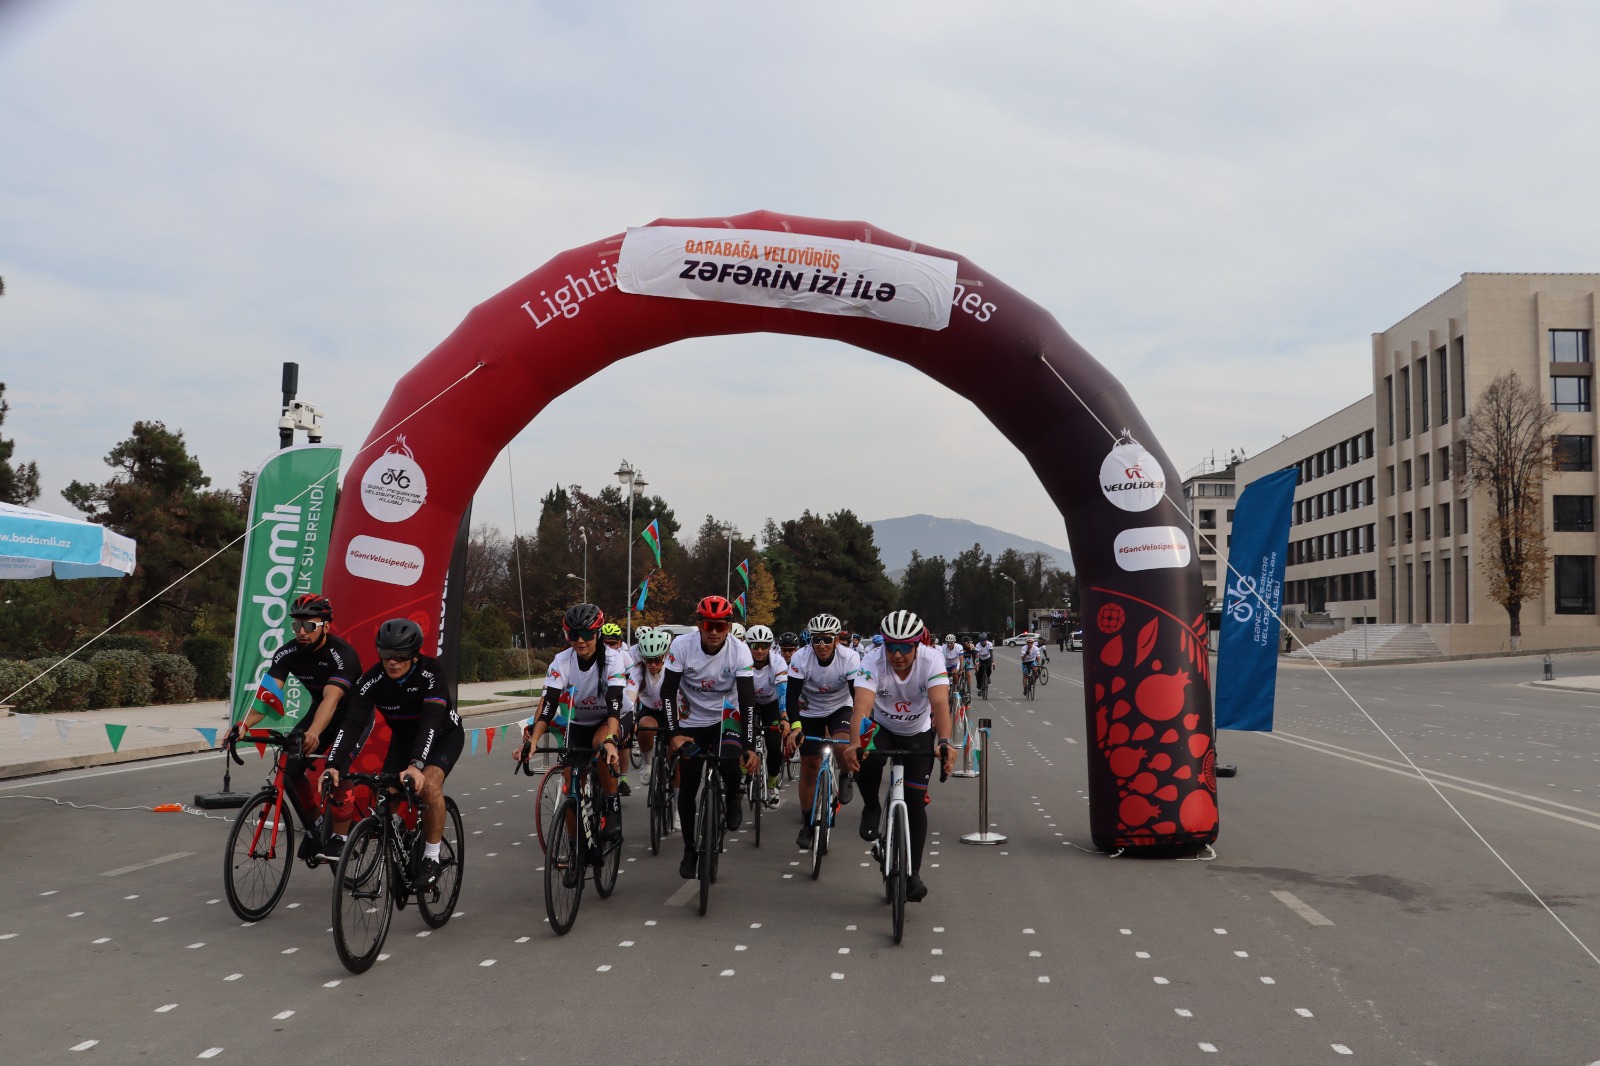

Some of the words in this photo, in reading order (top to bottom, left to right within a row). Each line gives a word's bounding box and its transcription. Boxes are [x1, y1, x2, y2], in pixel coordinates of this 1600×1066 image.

[685, 239, 759, 260] QARABAĞA
[764, 245, 840, 273] VELOYÜRÜŞ
[521, 259, 619, 329] Lighti
[302, 546, 315, 567] SU
